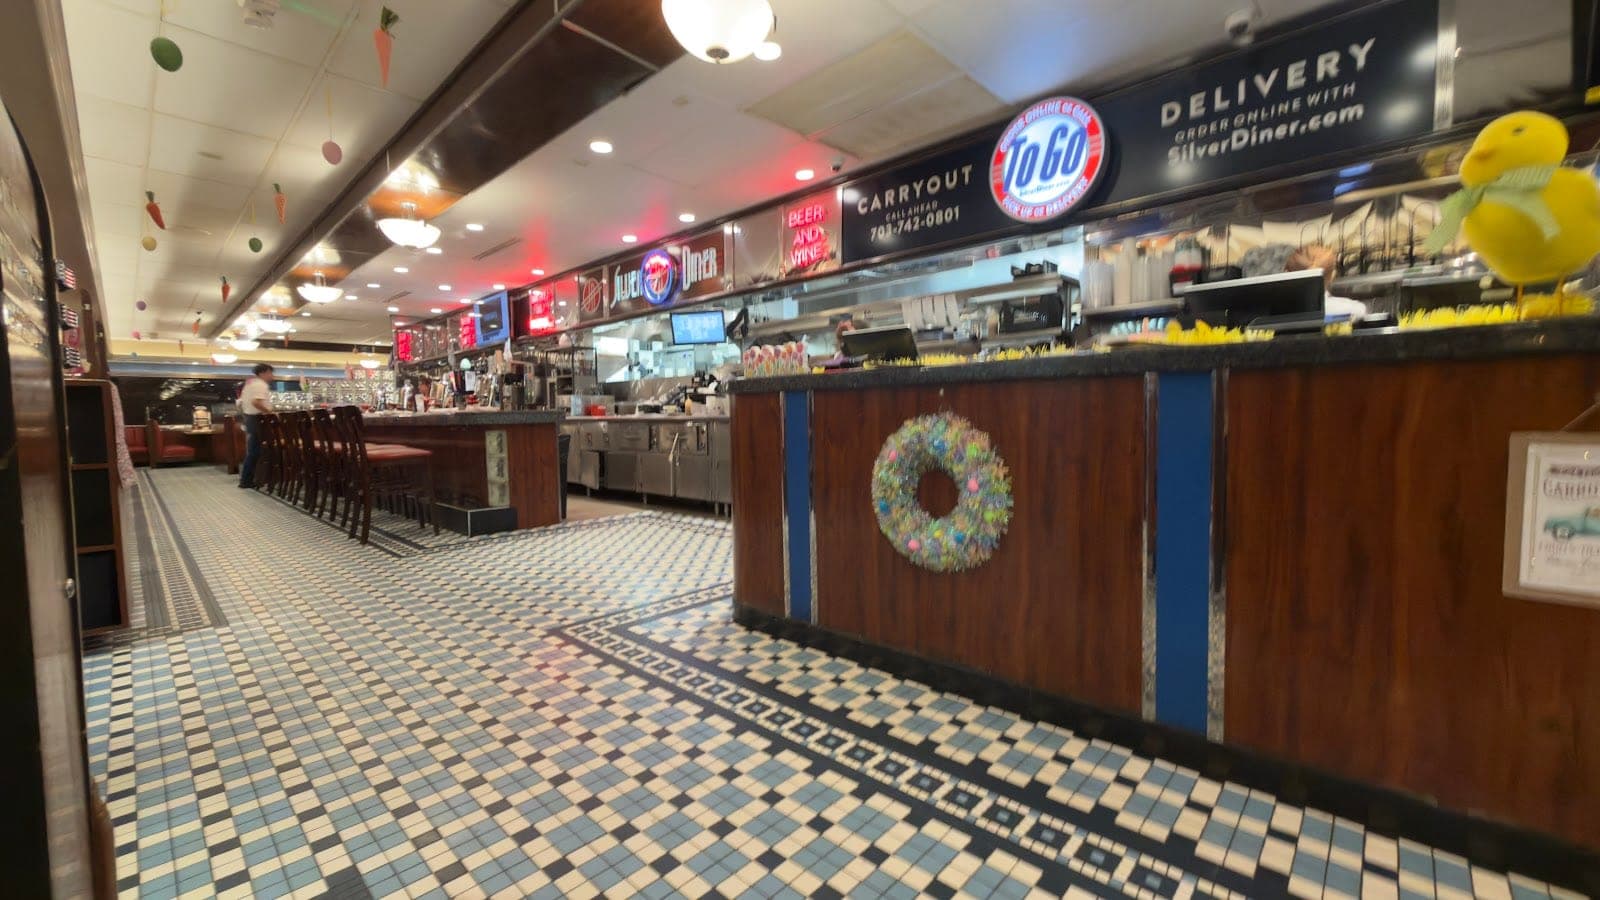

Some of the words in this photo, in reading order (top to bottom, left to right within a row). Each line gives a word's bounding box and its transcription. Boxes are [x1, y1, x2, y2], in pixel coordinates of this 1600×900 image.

[1161, 37, 1376, 128] DELIVERY
[1174, 117, 1229, 144] ORDER
[1233, 97, 1302, 129] ONLINE
[1307, 81, 1356, 108] WITH
[1167, 103, 1365, 167] SilverDiner.com
[857, 164, 972, 215] CARRYOUT
[788, 204, 823, 228] BEER
[871, 205, 960, 242] 703-742-0801
[908, 200, 938, 217] AHEAD
[793, 226, 820, 246] AND
[791, 244, 822, 267] WINE
